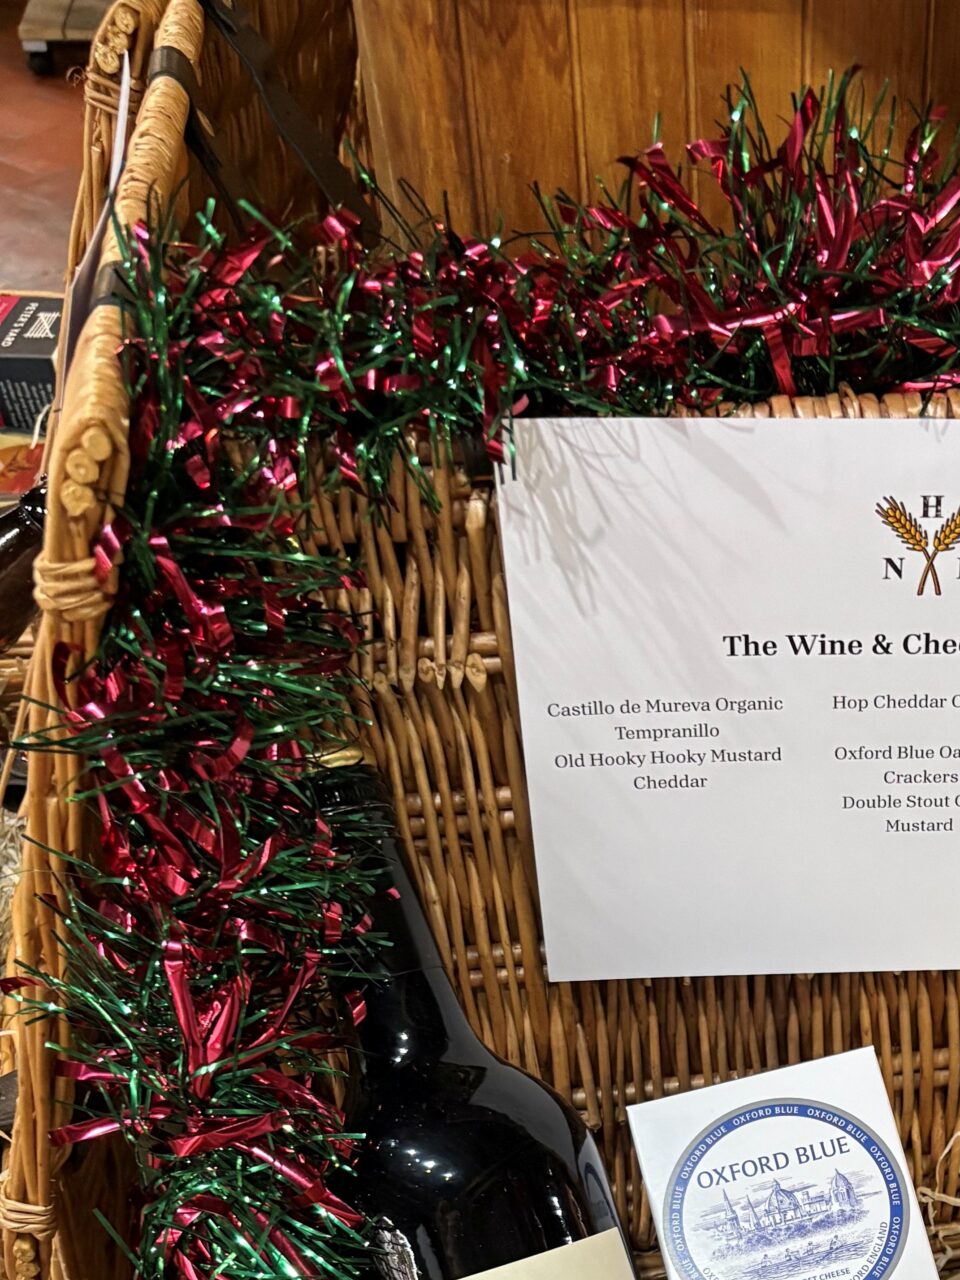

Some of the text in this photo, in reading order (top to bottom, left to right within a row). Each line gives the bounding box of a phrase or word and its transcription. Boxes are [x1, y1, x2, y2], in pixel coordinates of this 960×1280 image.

[920, 494, 945, 519] H
[882, 557, 905, 580] N
[722, 633, 778, 657] The
[785, 633, 863, 656] Wine
[871, 633, 894, 656] &
[547, 696, 784, 718] Castillo de Mureva Organic
[832, 694, 869, 713] Hop
[873, 693, 948, 709] Cheddar
[614, 723, 720, 742] Tempranillo
[554, 746, 782, 769] Old Hooky Hooky Mustard
[834, 745, 893, 761] Oxford
[896, 744, 935, 760] Blue
[633, 773, 708, 790] Cheddar
[883, 769, 959, 785] Crackers
[842, 794, 902, 810] Double
[906, 794, 951, 810] Stout
[885, 817, 954, 833] Mustard
[733, 1106, 799, 1126] OXFORD BLUE
[807, 1108, 869, 1143] OXFORD BLUE
[697, 1136, 850, 1189] OXFORD BLUE
[867, 1221, 888, 1264] ENGLAND
[819, 1267, 851, 1280] CHEESE
